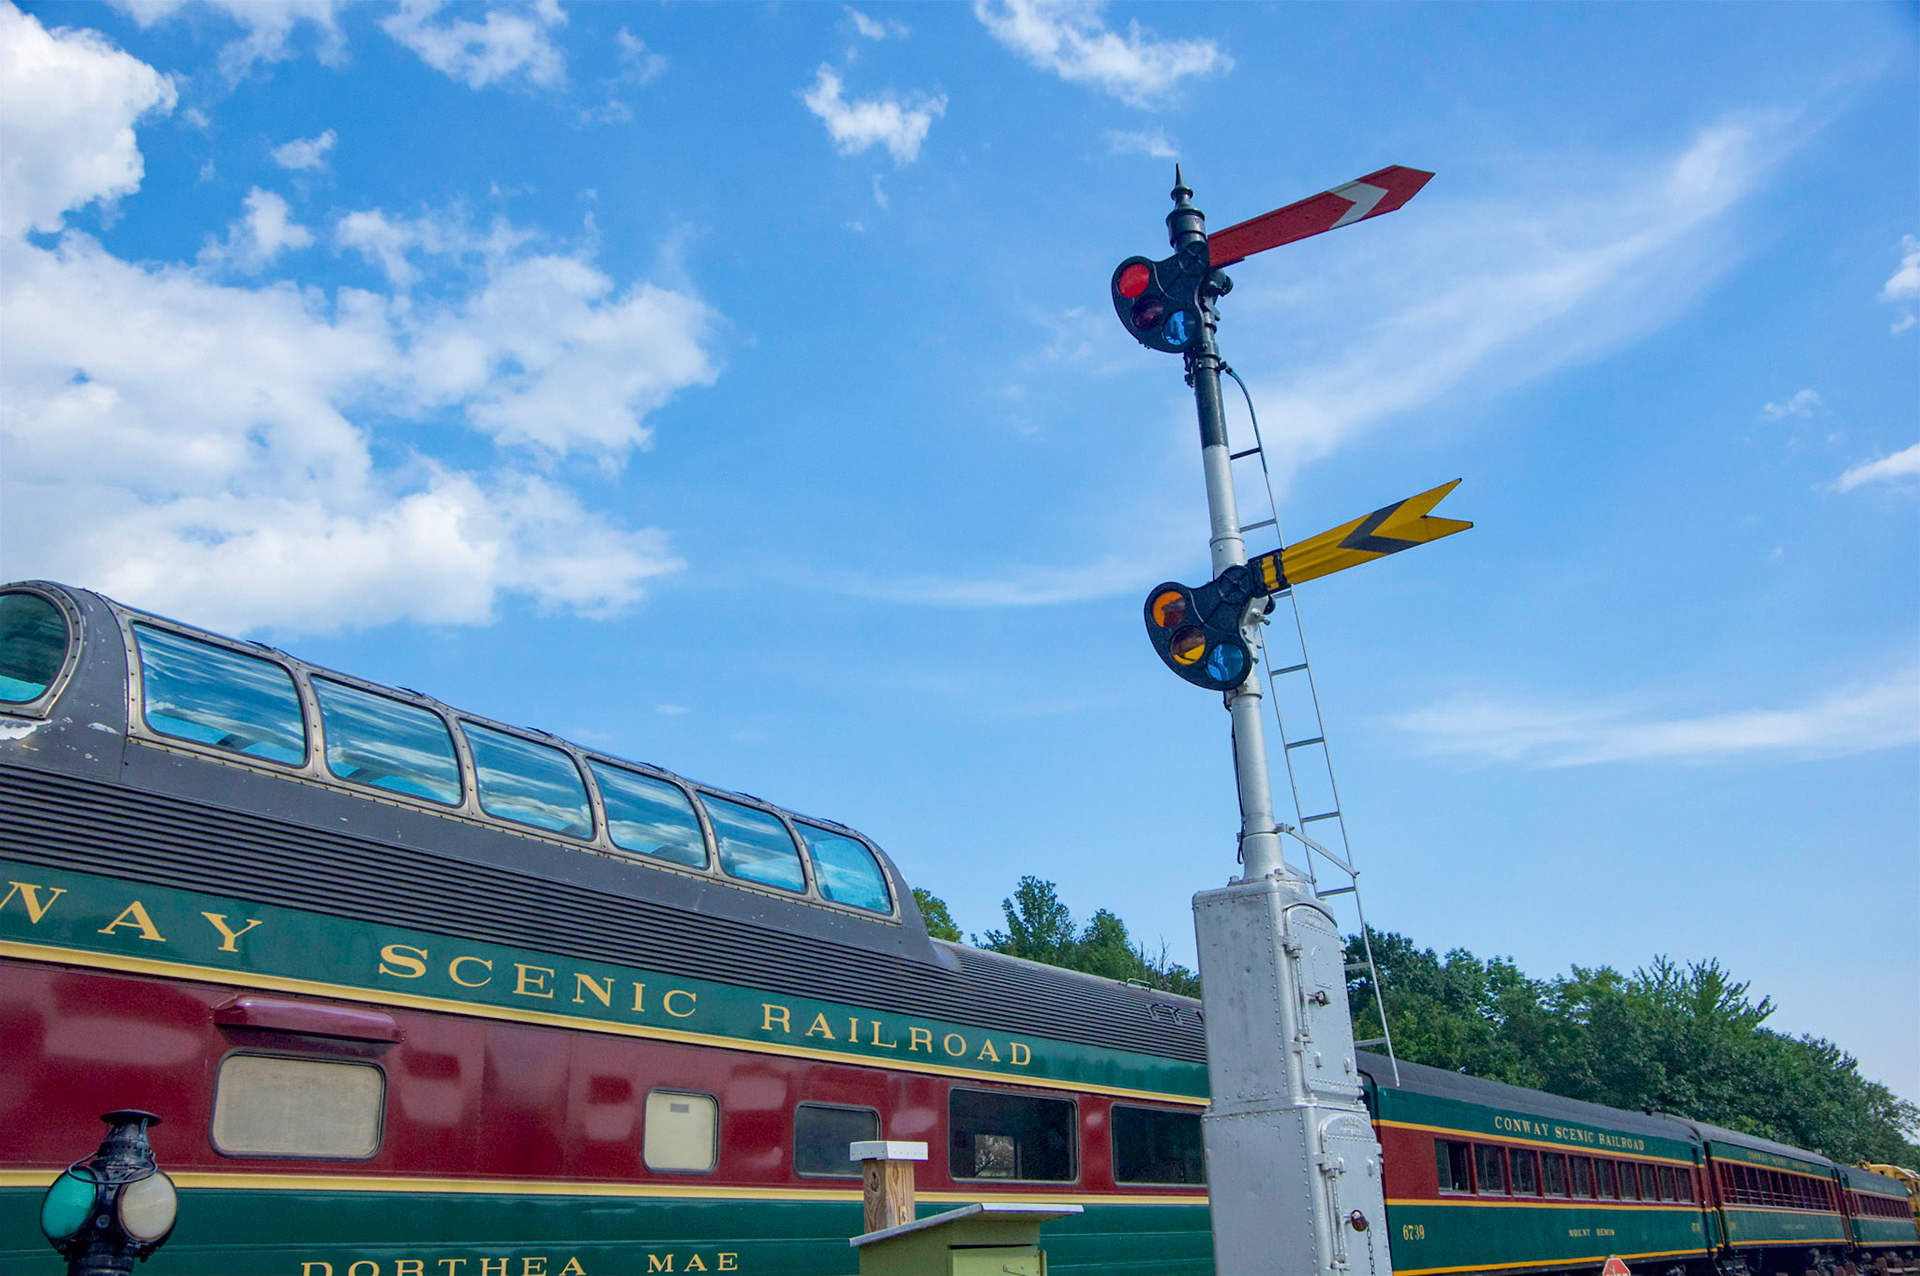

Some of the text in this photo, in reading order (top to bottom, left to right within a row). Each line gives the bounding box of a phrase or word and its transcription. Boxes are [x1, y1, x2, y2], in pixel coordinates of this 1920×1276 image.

[378, 944, 697, 1018] SCENIC
[761, 1003, 1032, 1066] RAILROAD
[1494, 1115, 1645, 1151] CONWAY SCENIC RAILROAD
[1568, 1228, 1591, 1237] MOUNT
[647, 1252, 738, 1273] MAE
